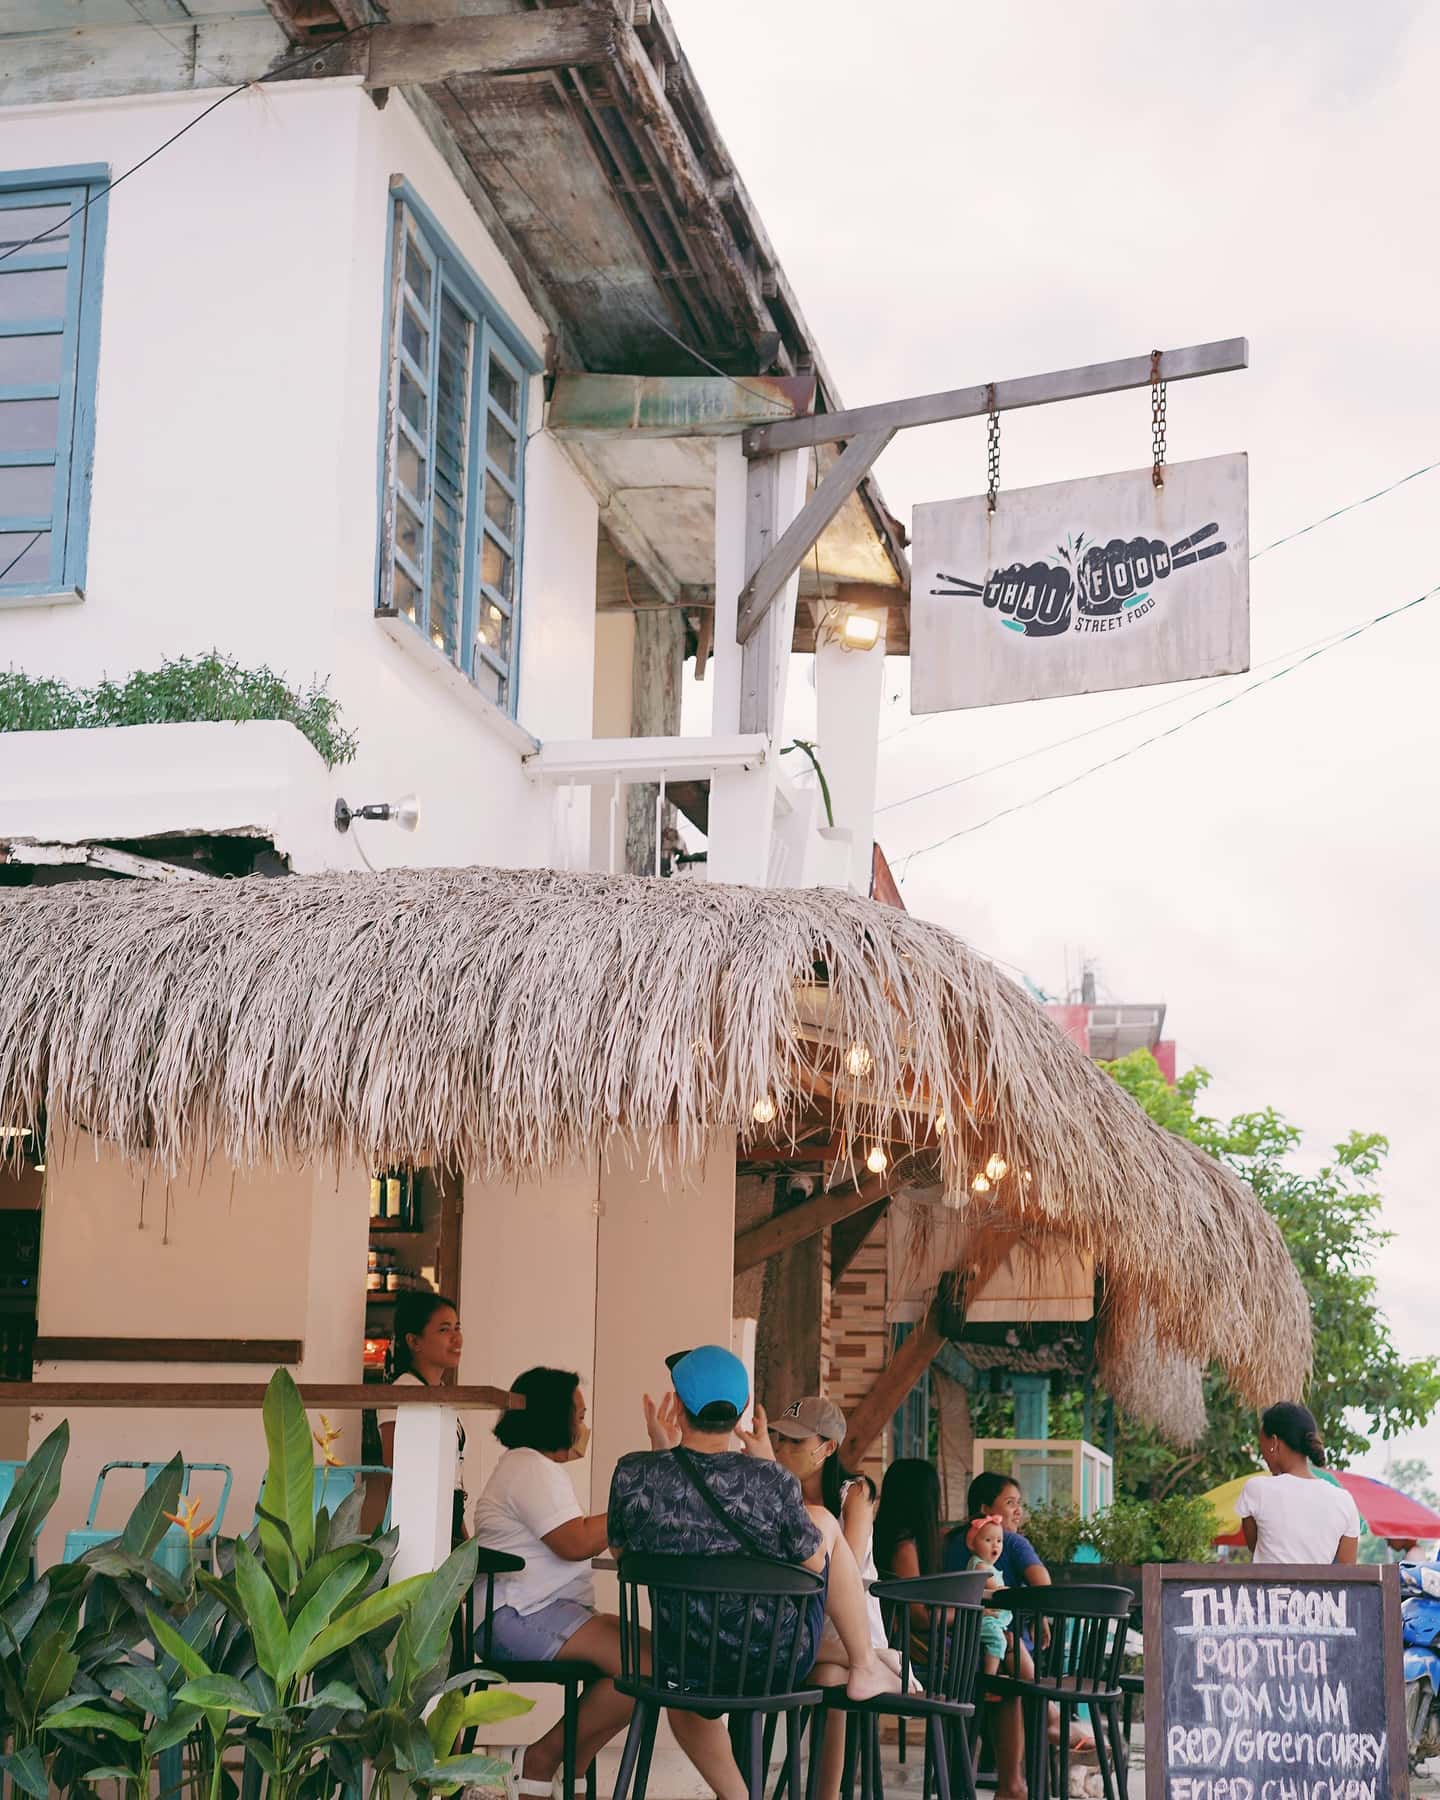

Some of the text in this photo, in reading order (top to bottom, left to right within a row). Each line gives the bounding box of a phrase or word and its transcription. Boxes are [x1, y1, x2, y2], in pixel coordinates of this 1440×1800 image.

[988, 582, 1057, 614] THAI
[1074, 598, 1156, 633] STREET FOOD
[783, 1400, 803, 1418] A
[1192, 1681, 1273, 1722] TOM
